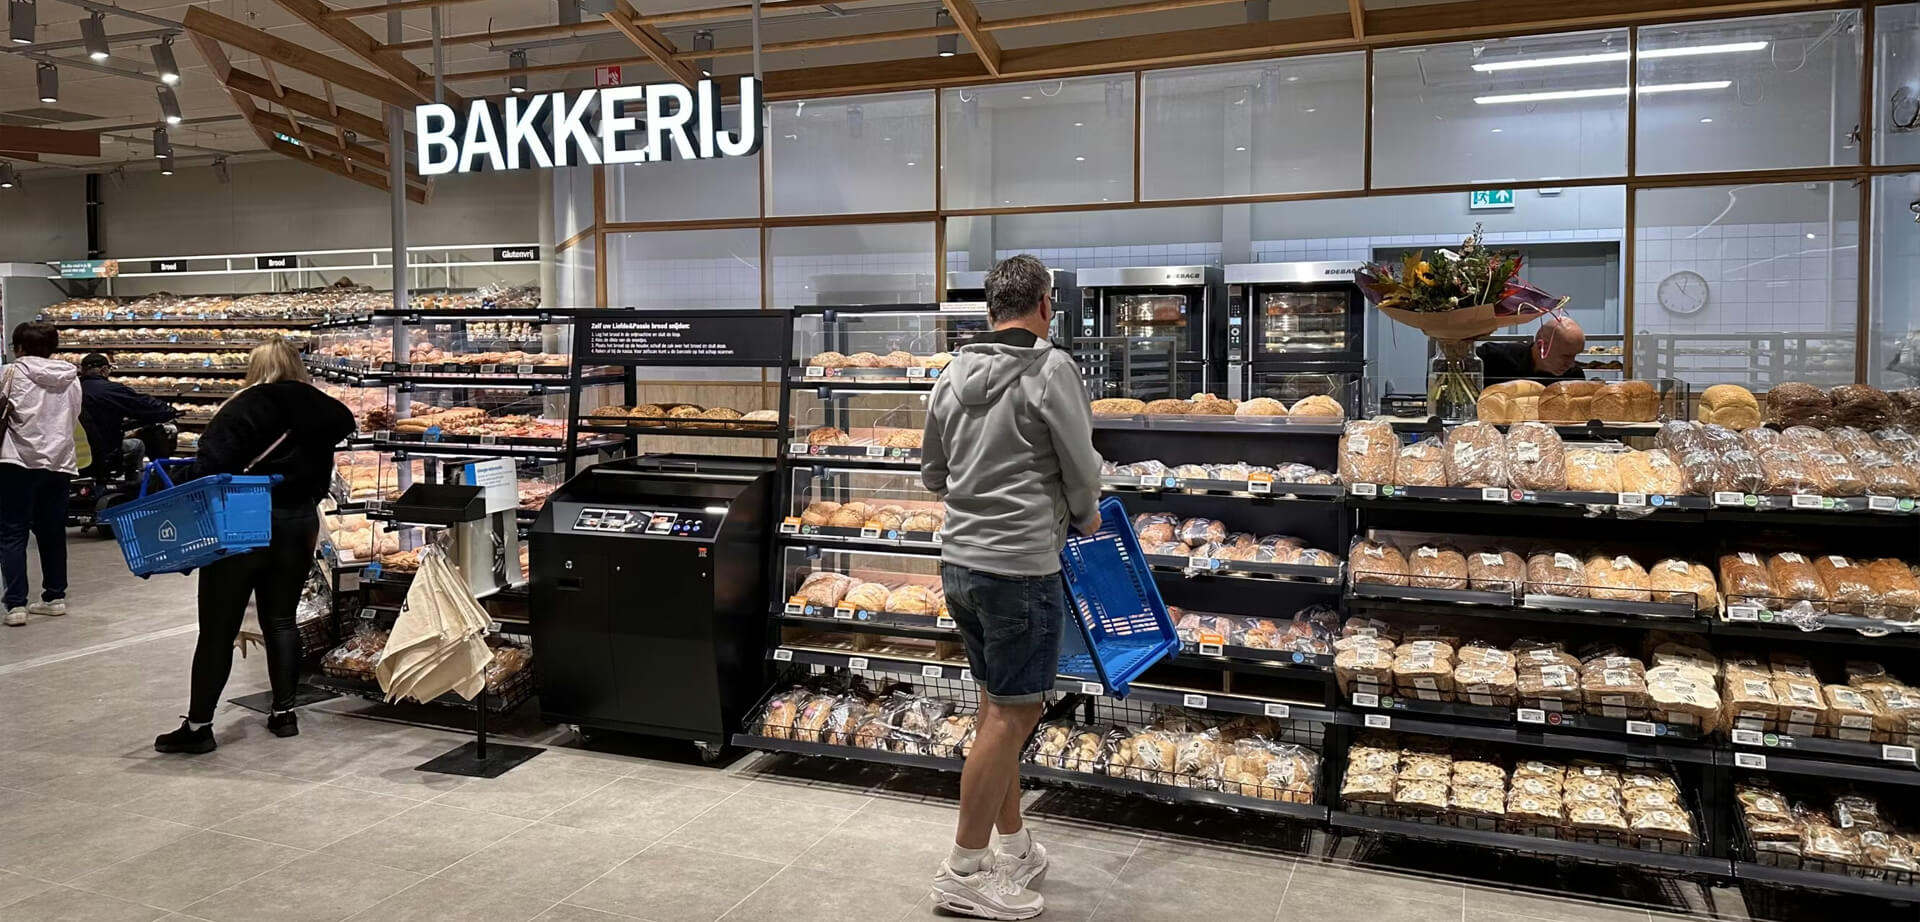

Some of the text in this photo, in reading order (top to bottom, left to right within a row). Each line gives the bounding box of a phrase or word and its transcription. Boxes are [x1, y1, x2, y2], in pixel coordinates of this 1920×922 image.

[416, 76, 757, 176] BAKKERIJ
[161, 263, 177, 271] Brood
[268, 258, 285, 267] Brood
